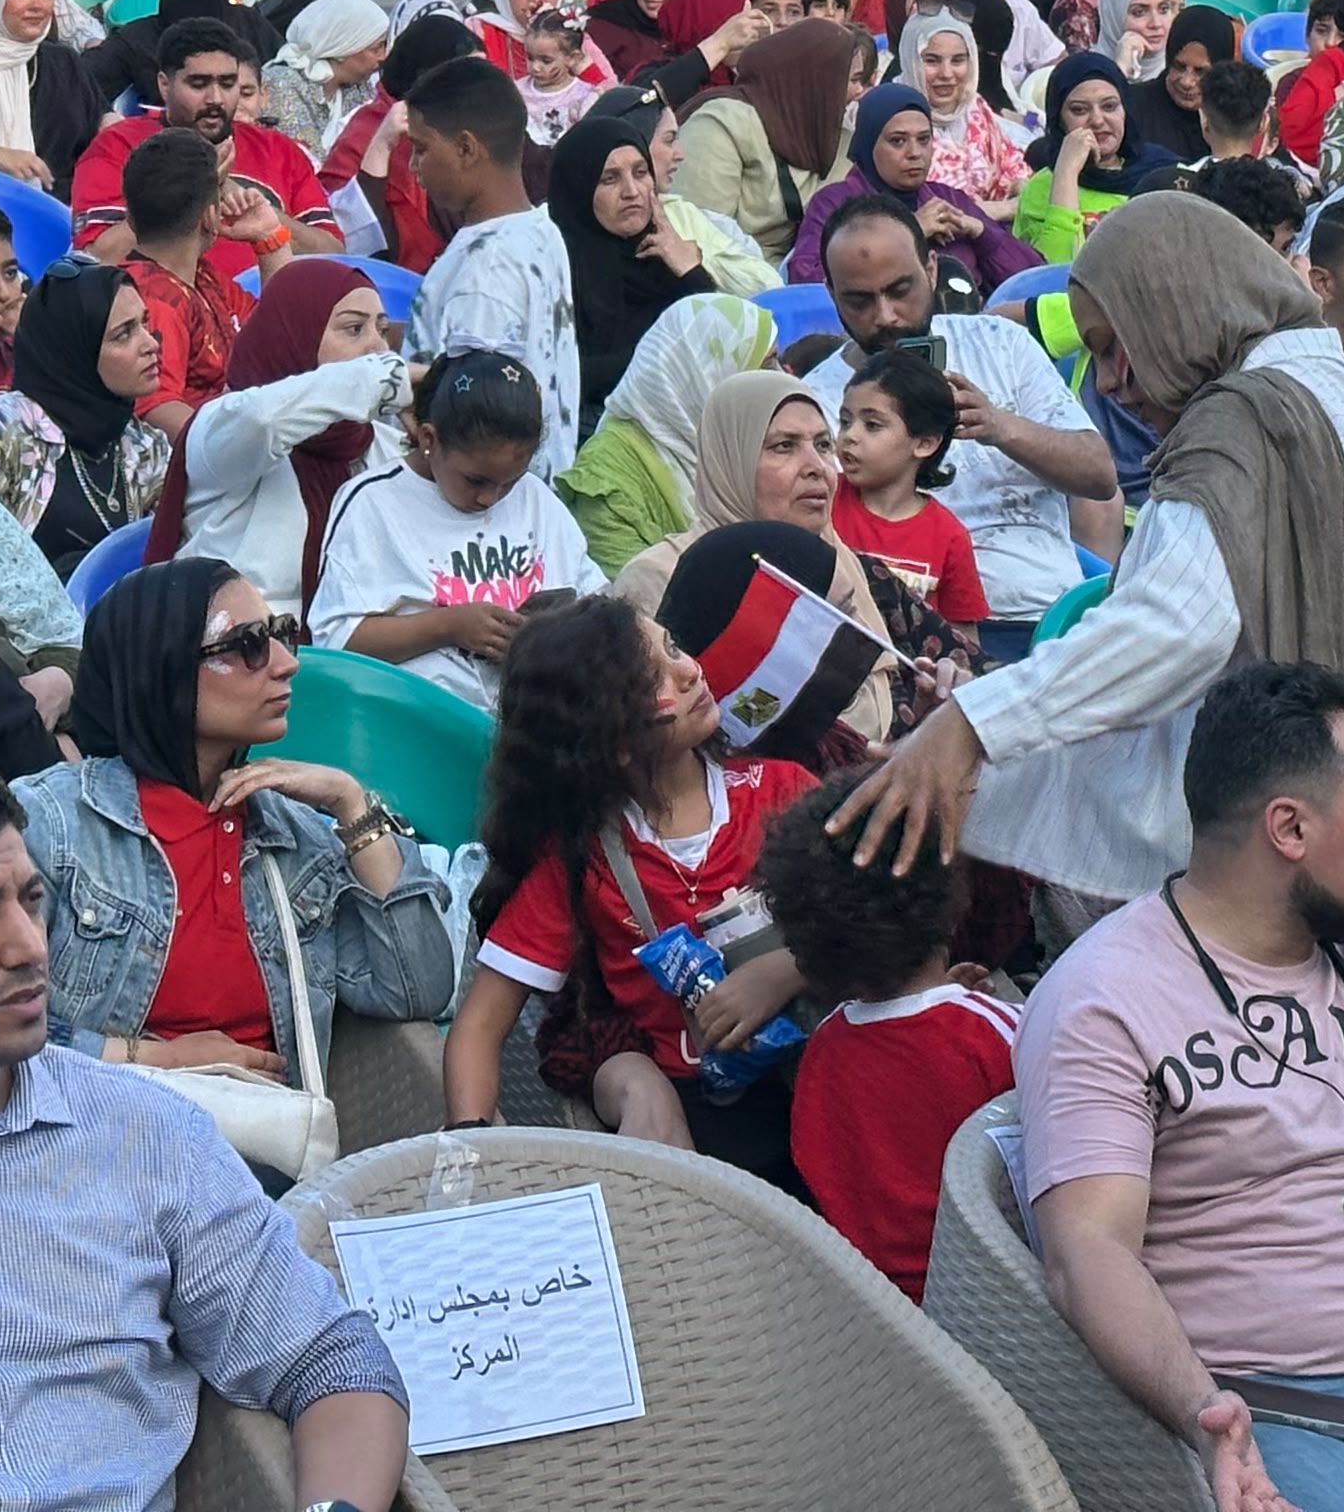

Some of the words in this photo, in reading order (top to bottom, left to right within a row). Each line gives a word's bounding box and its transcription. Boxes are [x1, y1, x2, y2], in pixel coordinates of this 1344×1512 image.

[451, 535, 531, 584] MAKE
[427, 1284, 511, 1324] بمجلس
[521, 1263, 593, 1306] خاص
[449, 1335, 522, 1382] المركز
